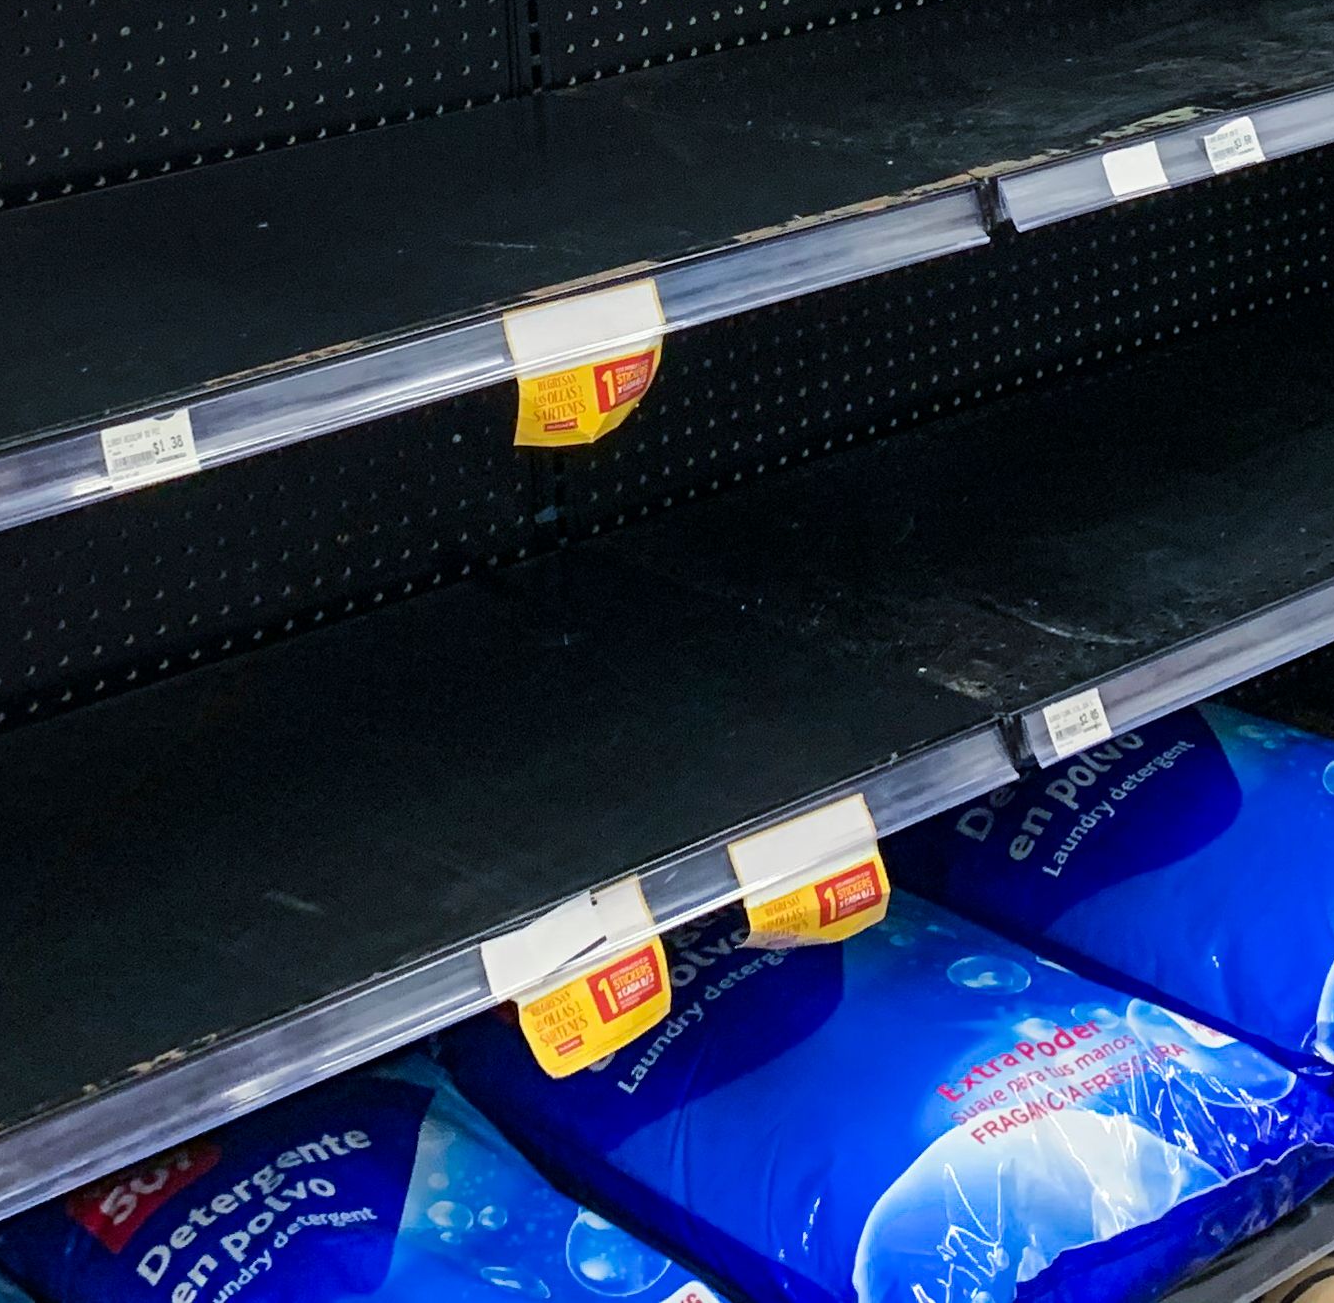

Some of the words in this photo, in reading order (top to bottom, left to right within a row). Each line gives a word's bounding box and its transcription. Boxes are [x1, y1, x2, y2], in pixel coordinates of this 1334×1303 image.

[533, 400, 587, 422] SARTENES
[601, 369, 617, 406] 1
[1045, 733, 1145, 811] polvo
[1009, 805, 1053, 862] en
[1042, 800, 1116, 878] Laundry
[1110, 739, 1196, 801] detergent
[824, 886, 838, 920] 1
[836, 880, 873, 900] STICKERS
[597, 977, 619, 1014] 1
[617, 1001, 705, 1095] Laundry
[936, 1050, 1018, 1103] Extra
[1015, 1019, 1103, 1061] Poder
[950, 1088, 1008, 1126] Suave
[1044, 1061, 1076, 1080] tus
[1074, 1034, 1136, 1071] manos
[971, 1084, 1085, 1146] FRAGANCIA
[136, 1129, 372, 1287] Detergente
[273, 1206, 378, 1249] detergent
[171, 1253, 218, 1303] en
[220, 1177, 337, 1263] polvo
